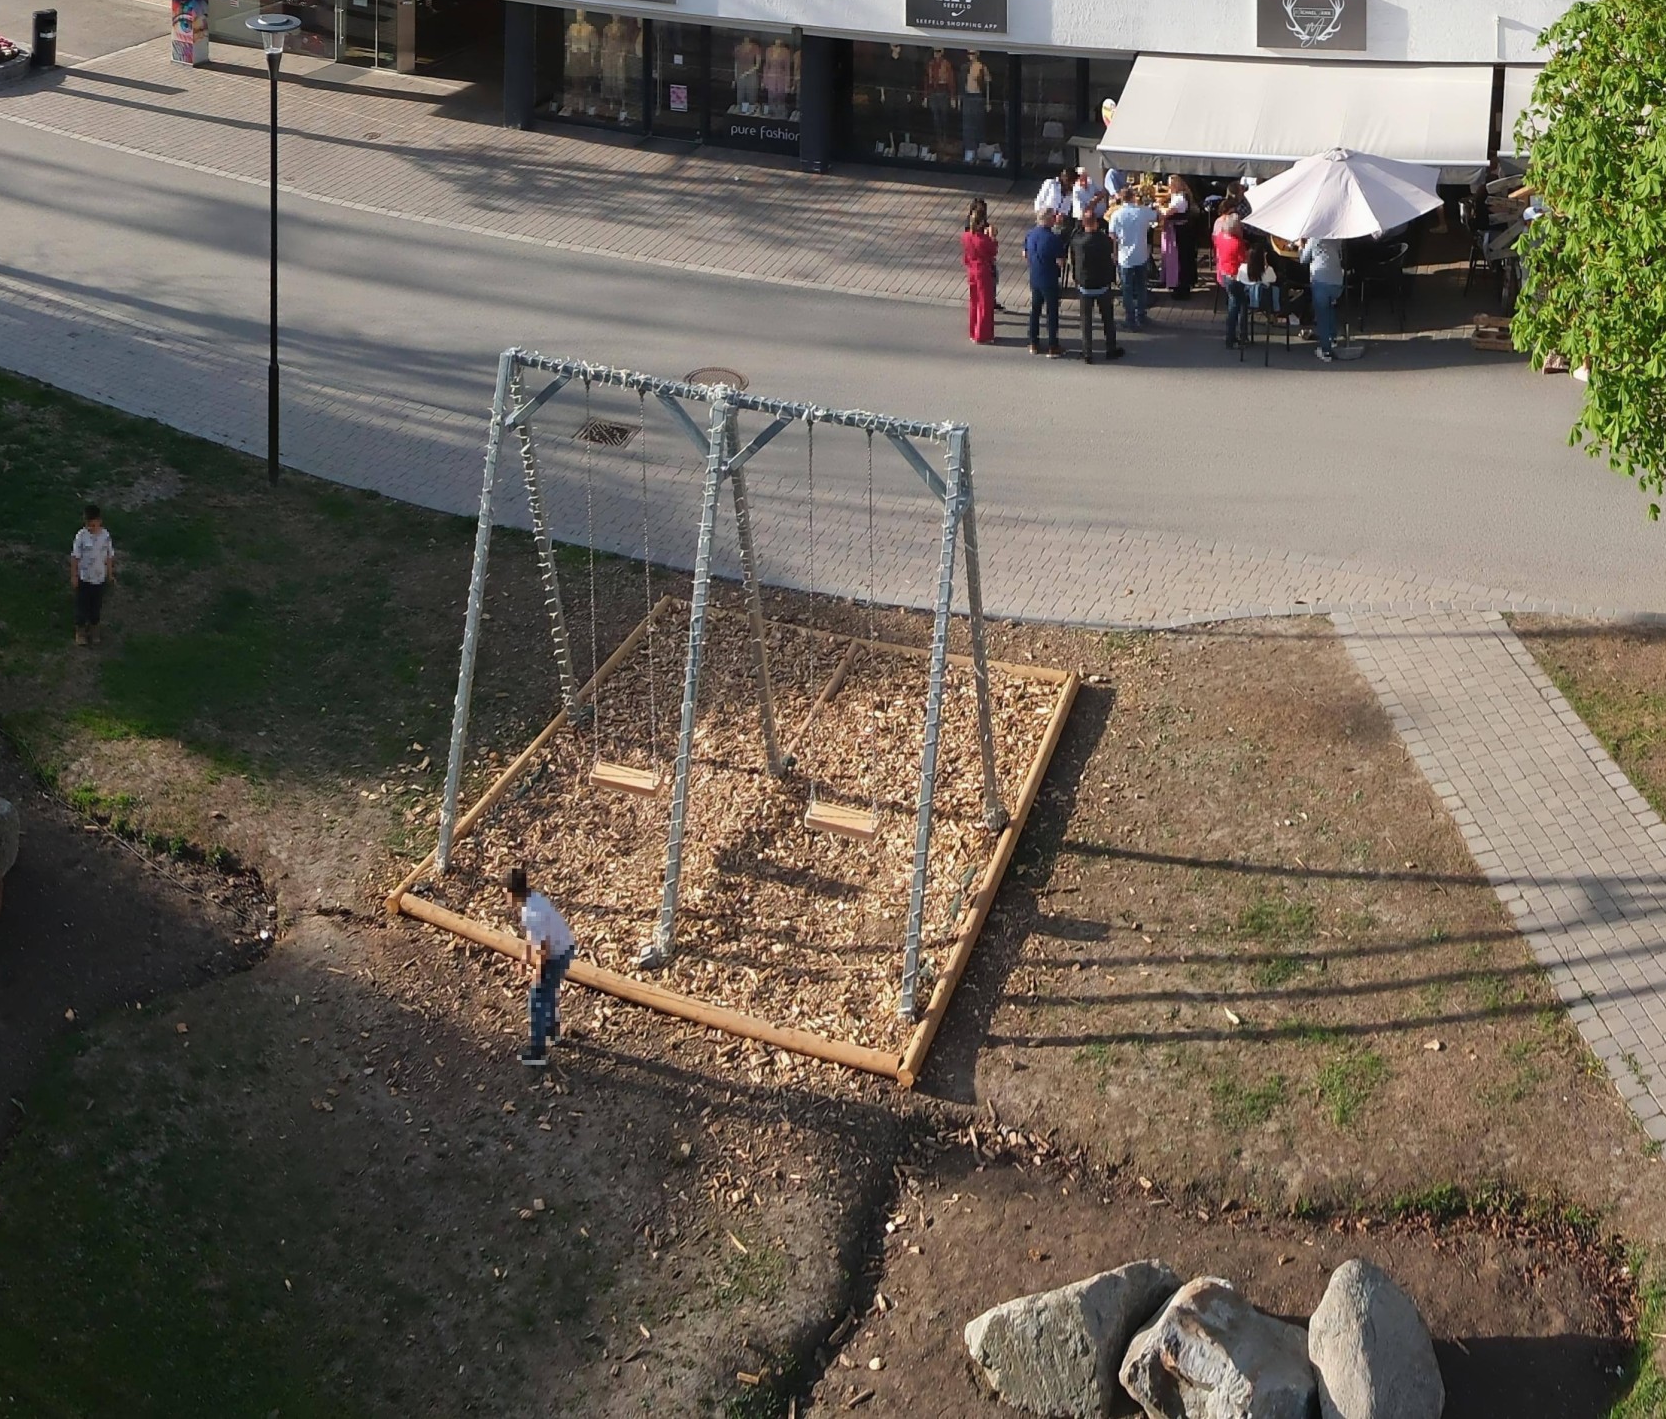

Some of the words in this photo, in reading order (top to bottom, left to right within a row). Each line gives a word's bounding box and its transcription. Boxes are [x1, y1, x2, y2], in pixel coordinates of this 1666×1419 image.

[943, 2, 972, 10] SEEFELD
[916, 18, 944, 26] SEEFELD
[947, 20, 982, 28] SHOPPING
[731, 125, 756, 136] pure
